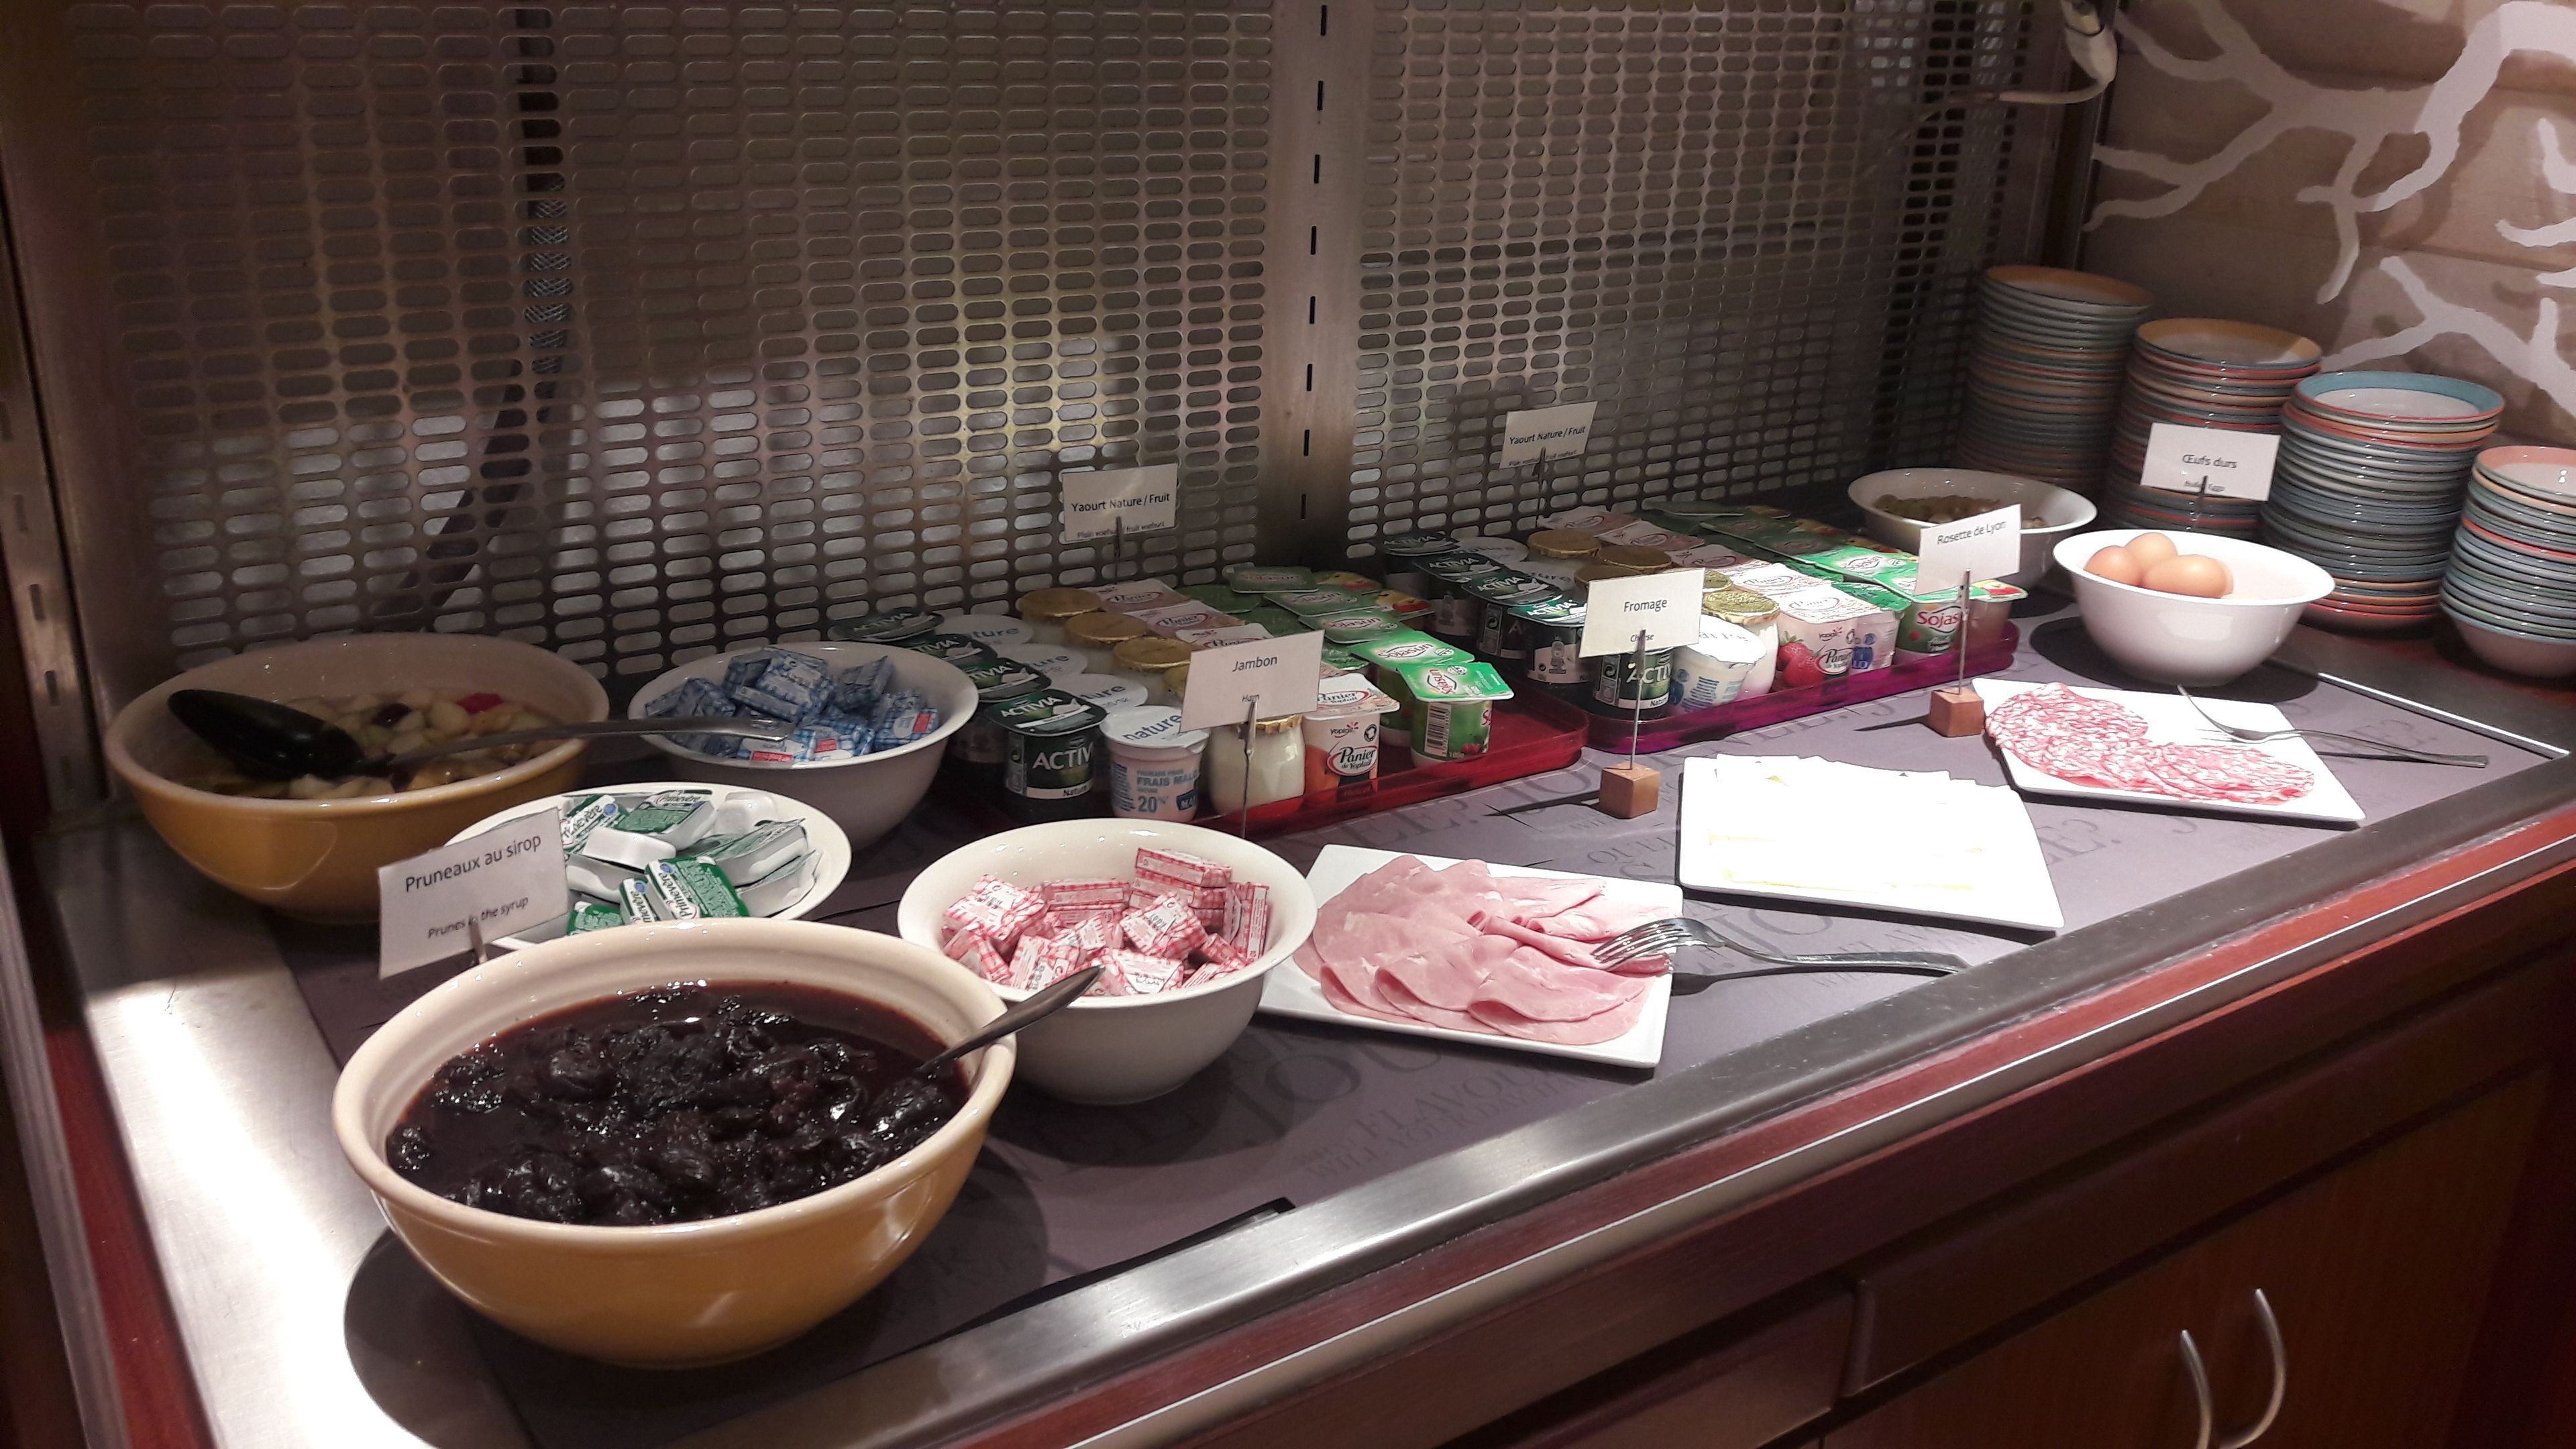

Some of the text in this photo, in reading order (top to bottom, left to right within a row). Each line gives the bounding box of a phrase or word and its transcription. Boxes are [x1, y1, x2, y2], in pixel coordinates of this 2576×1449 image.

[1509, 434, 1535, 445] Yaourt
[1537, 430, 1563, 441] Nature
[1568, 426, 1585, 435] Fruit
[2214, 458, 2237, 468] durs
[1071, 501, 1106, 513] Yaourt
[1109, 498, 1142, 509] Nature
[1149, 493, 1170, 503] Fruit
[1937, 521, 2006, 545] Rosette de Lyon
[1428, 557, 1480, 569] ACTIVIA
[1477, 576, 1525, 592] ACTIVIA
[1526, 601, 1578, 616] ACTIVIA
[1623, 599, 1668, 612] Fromage
[853, 612, 913, 632] ACTIVIA
[1377, 642, 1435, 659] Sojasun
[1232, 655, 1278, 672] Jambon
[1000, 696, 1063, 718] ACTIVIA
[1122, 714, 1182, 741] nature
[1340, 747, 1376, 763] Panier
[405, 835, 542, 892] Pruneaux au sirop
[428, 919, 465, 939] Prunes
[500, 896, 529, 915] syrup
